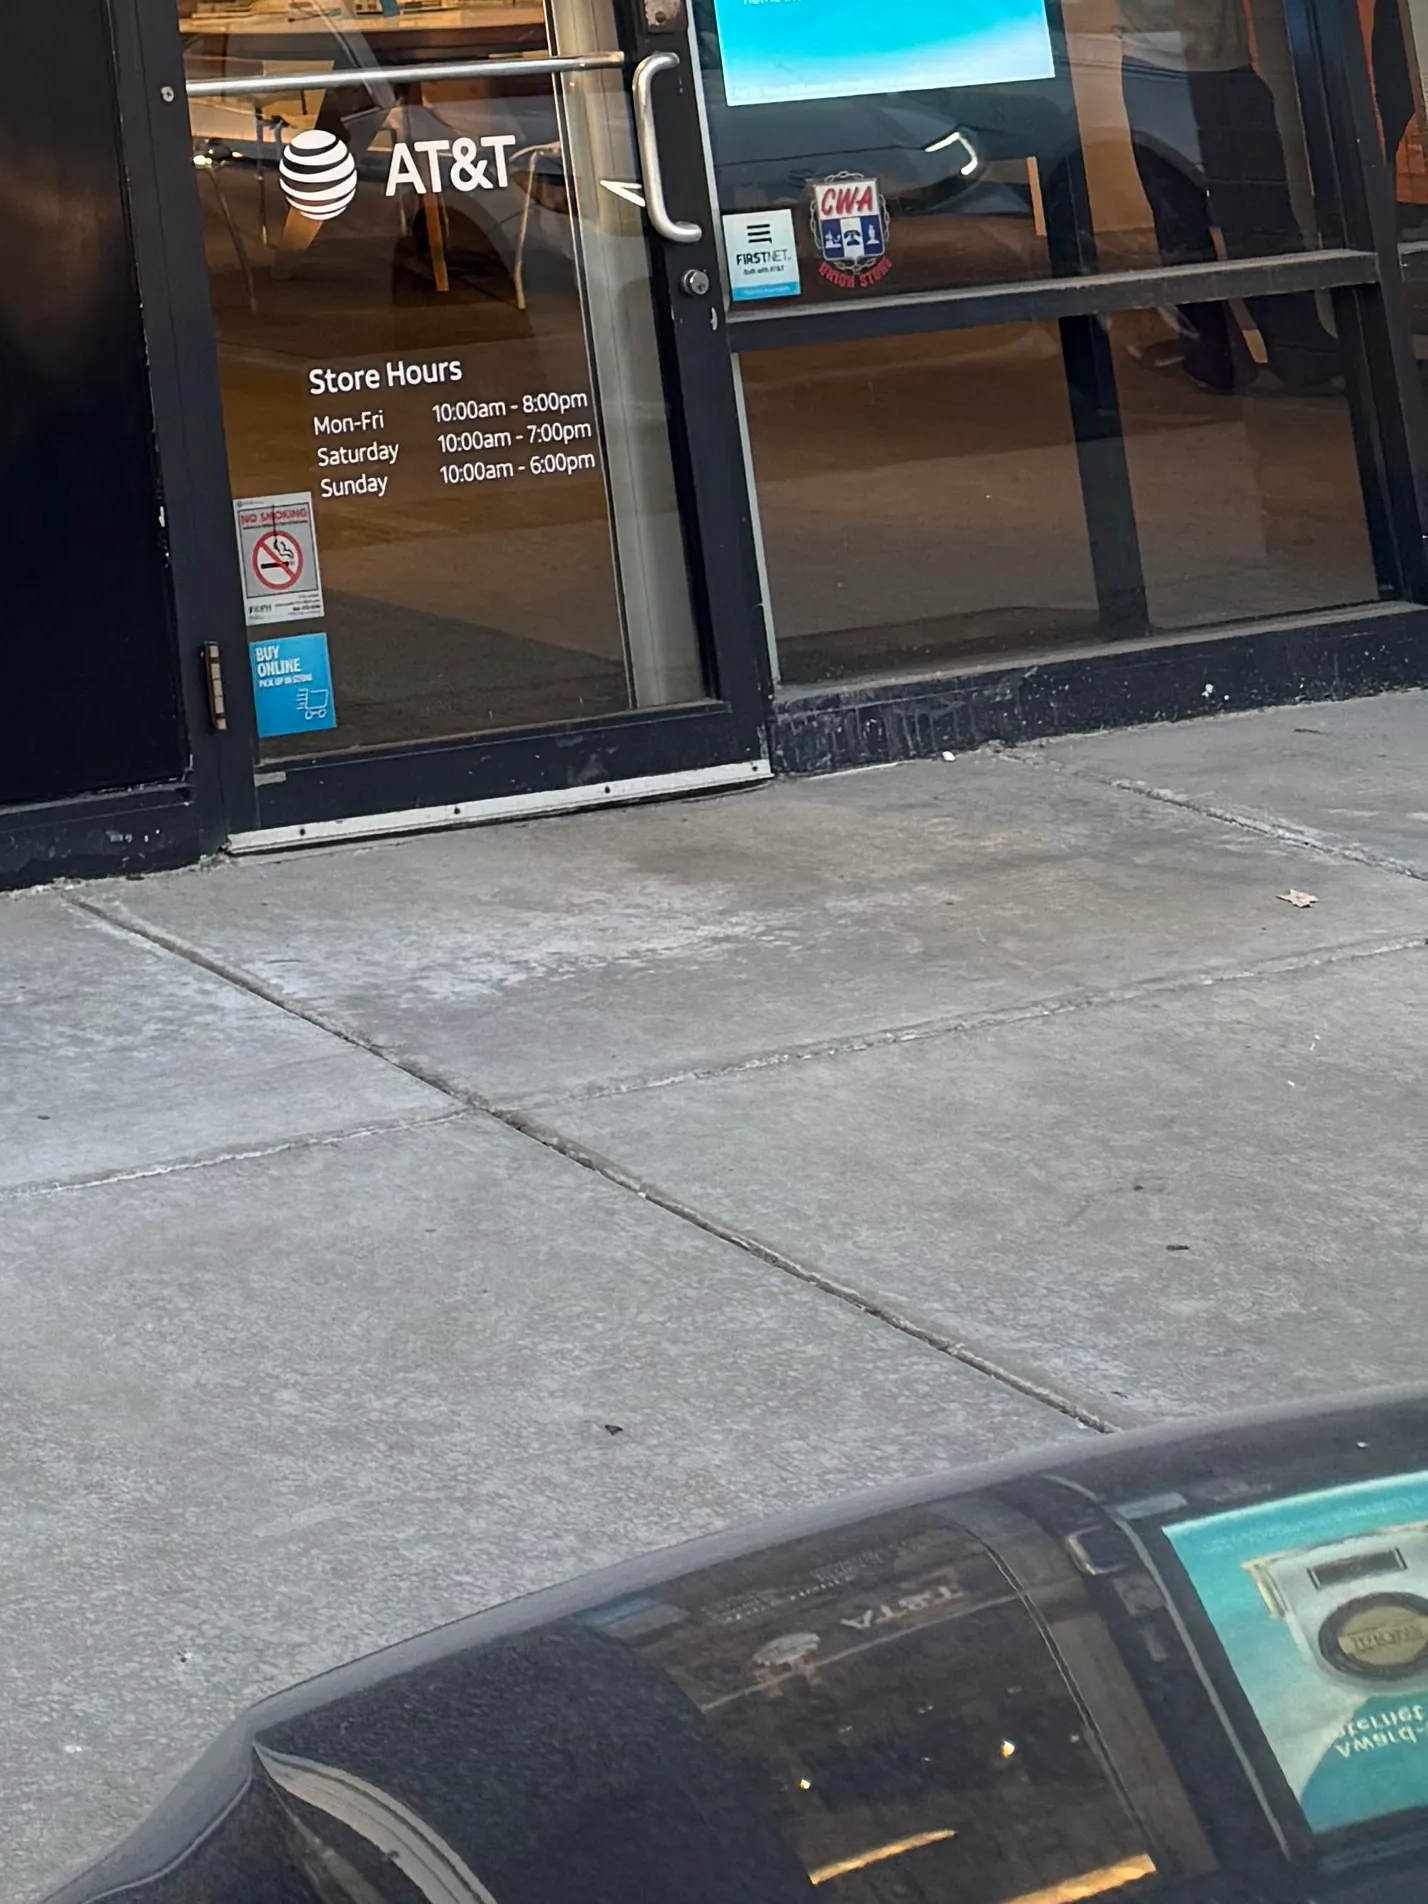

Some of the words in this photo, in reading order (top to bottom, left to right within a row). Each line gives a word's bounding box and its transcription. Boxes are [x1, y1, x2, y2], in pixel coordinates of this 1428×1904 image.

[385, 134, 516, 196] AT&T
[821, 185, 873, 216] CWA
[309, 367, 380, 395] Store
[386, 359, 463, 388] Hours
[313, 409, 385, 436] Mon-Fri
[432, 400, 506, 423] 10:00am
[522, 391, 588, 414] 8:00pm
[316, 442, 399, 467] Saturday
[437, 430, 512, 454] 10:00am
[526, 421, 592, 444] 7:00pm
[320, 474, 388, 497] Sunday
[439, 460, 514, 484] 10:00am
[530, 452, 595, 475] 6:00pm
[240, 514, 258, 524] NO
[255, 645, 280, 662] BUY
[257, 658, 302, 677] ONLINE
